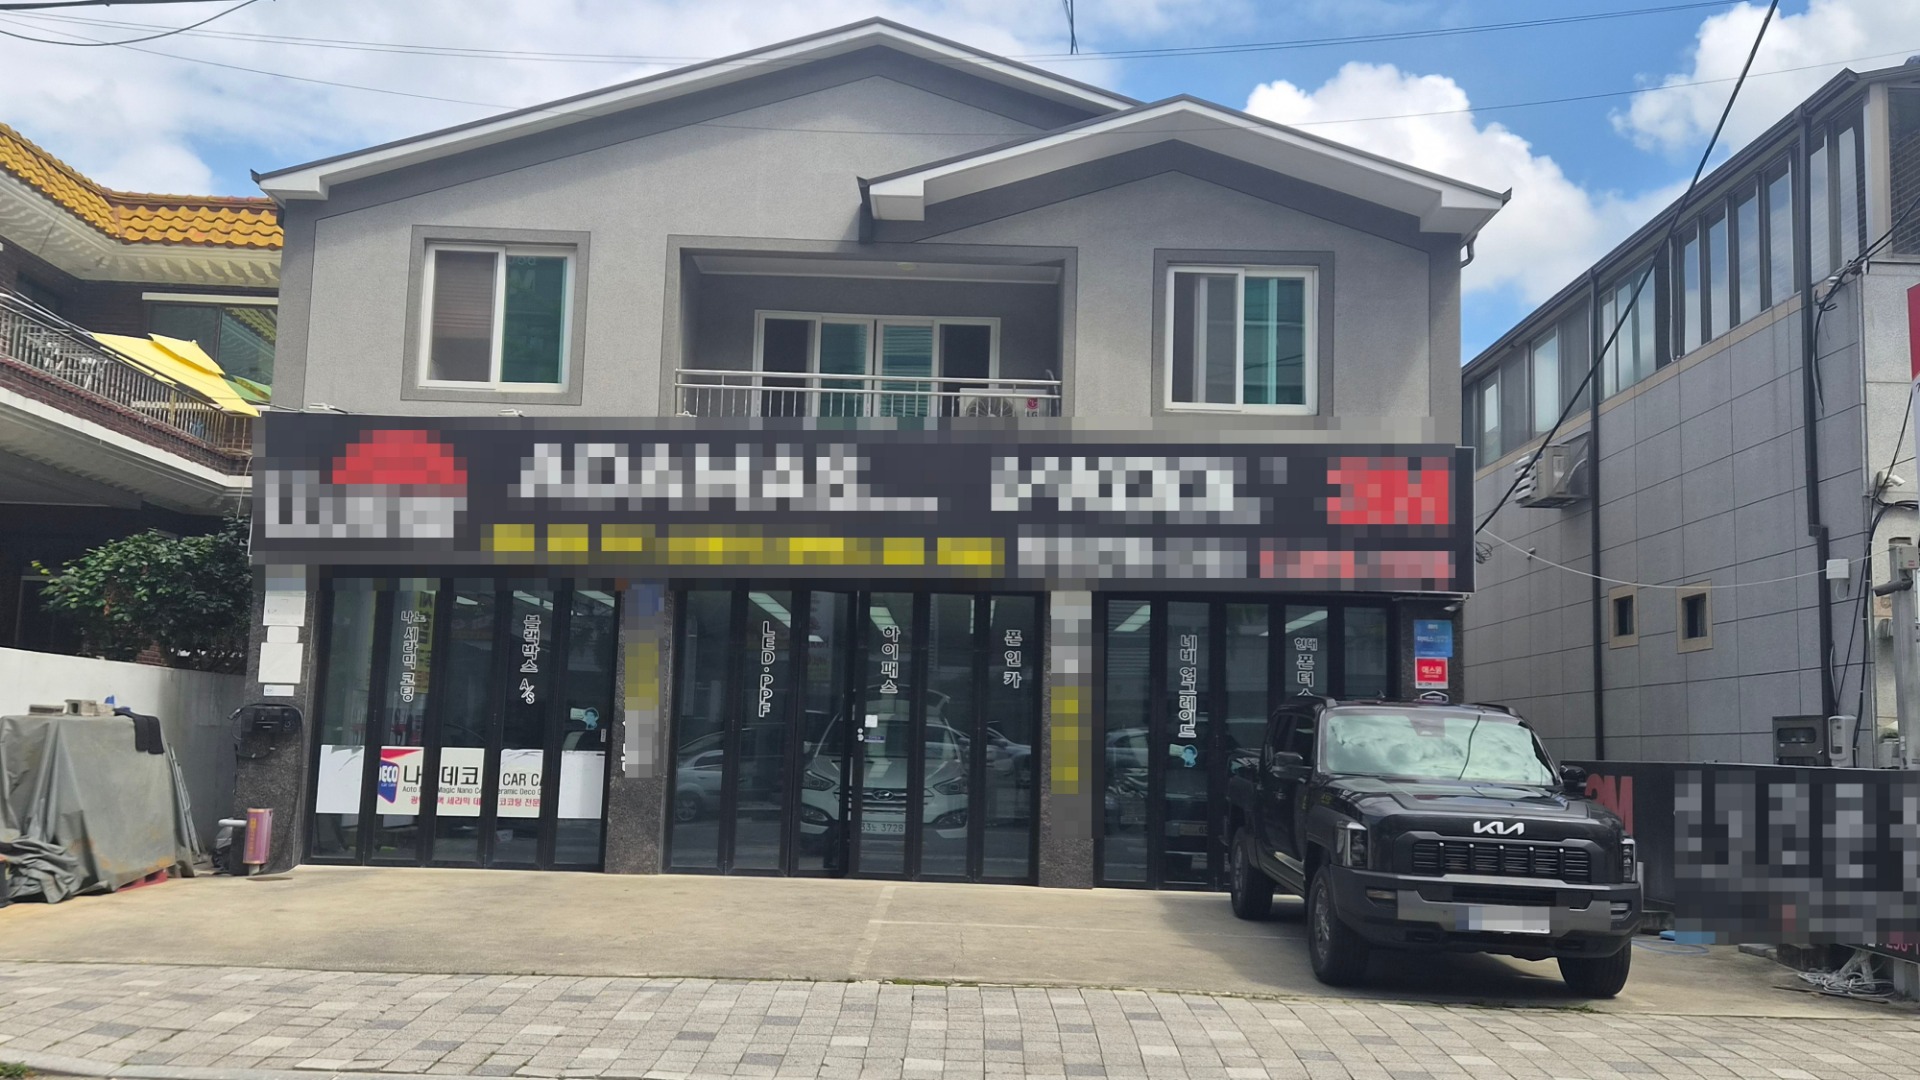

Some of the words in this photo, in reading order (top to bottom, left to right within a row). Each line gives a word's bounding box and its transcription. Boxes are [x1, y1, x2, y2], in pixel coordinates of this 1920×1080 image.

[401, 610, 427, 624] 나노
[403, 626, 419, 670] 세라믹
[520, 614, 541, 673] 블랙박스
[1180, 634, 1197, 665] 네비
[880, 625, 901, 694] 하이패스
[1003, 629, 1023, 689] 폰인카
[400, 672, 416, 702] 코팅
[519, 678, 535, 704] A/S
[1178, 667, 1197, 738] 업그레이드
[441, 766, 479, 786] 데코
[502, 773, 527, 787] CAR
[456, 786, 473, 794] Nano
[1473, 820, 1525, 836] KIA
